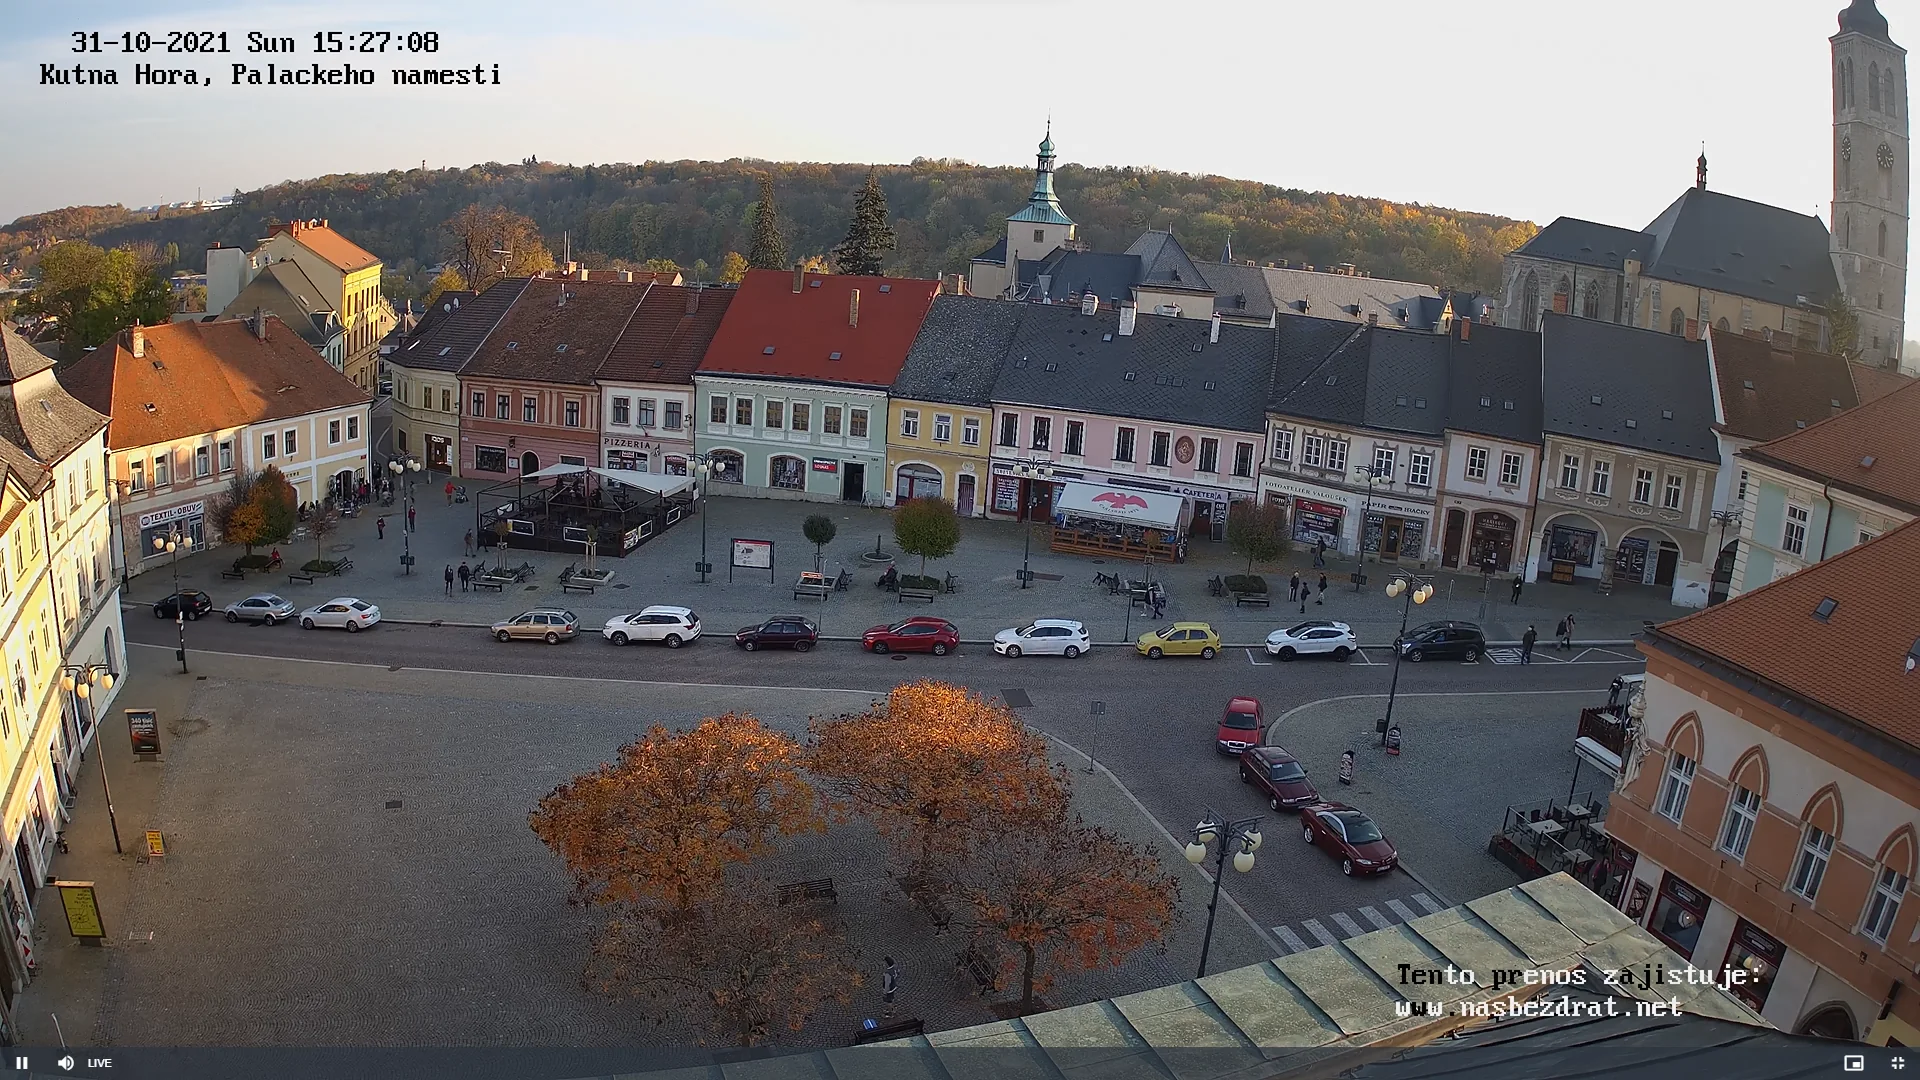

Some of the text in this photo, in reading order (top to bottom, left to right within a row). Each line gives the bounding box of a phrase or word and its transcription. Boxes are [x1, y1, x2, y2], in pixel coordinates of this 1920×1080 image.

[603, 437, 651, 449] PIZZERIA
[1182, 488, 1222, 500] CAFETERIA
[1404, 507, 1431, 516] HRAČKY
